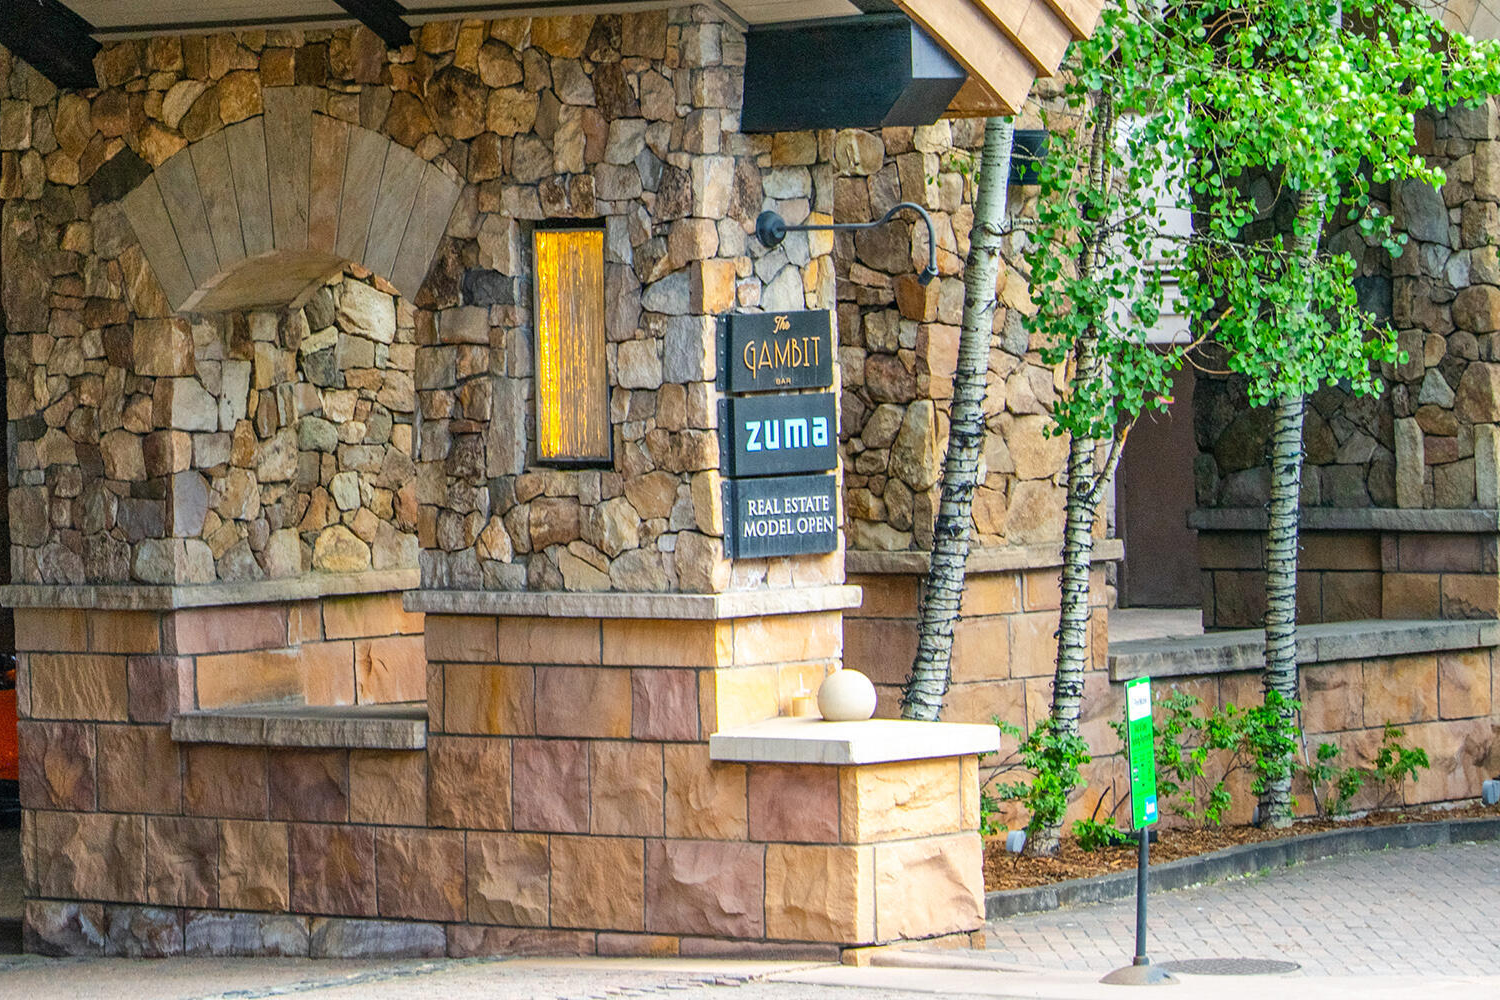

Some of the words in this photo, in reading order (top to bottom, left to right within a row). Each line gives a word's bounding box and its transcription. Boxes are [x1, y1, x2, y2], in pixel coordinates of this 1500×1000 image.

[772, 315, 791, 334] The
[743, 336, 820, 379] GAMBIT
[775, 377, 791, 385] BAR
[745, 416, 829, 452] zuma
[748, 498, 781, 516] REAL
[783, 495, 830, 514] ESTATE
[743, 518, 795, 538] MODEL
[796, 515, 834, 534] OPEN
